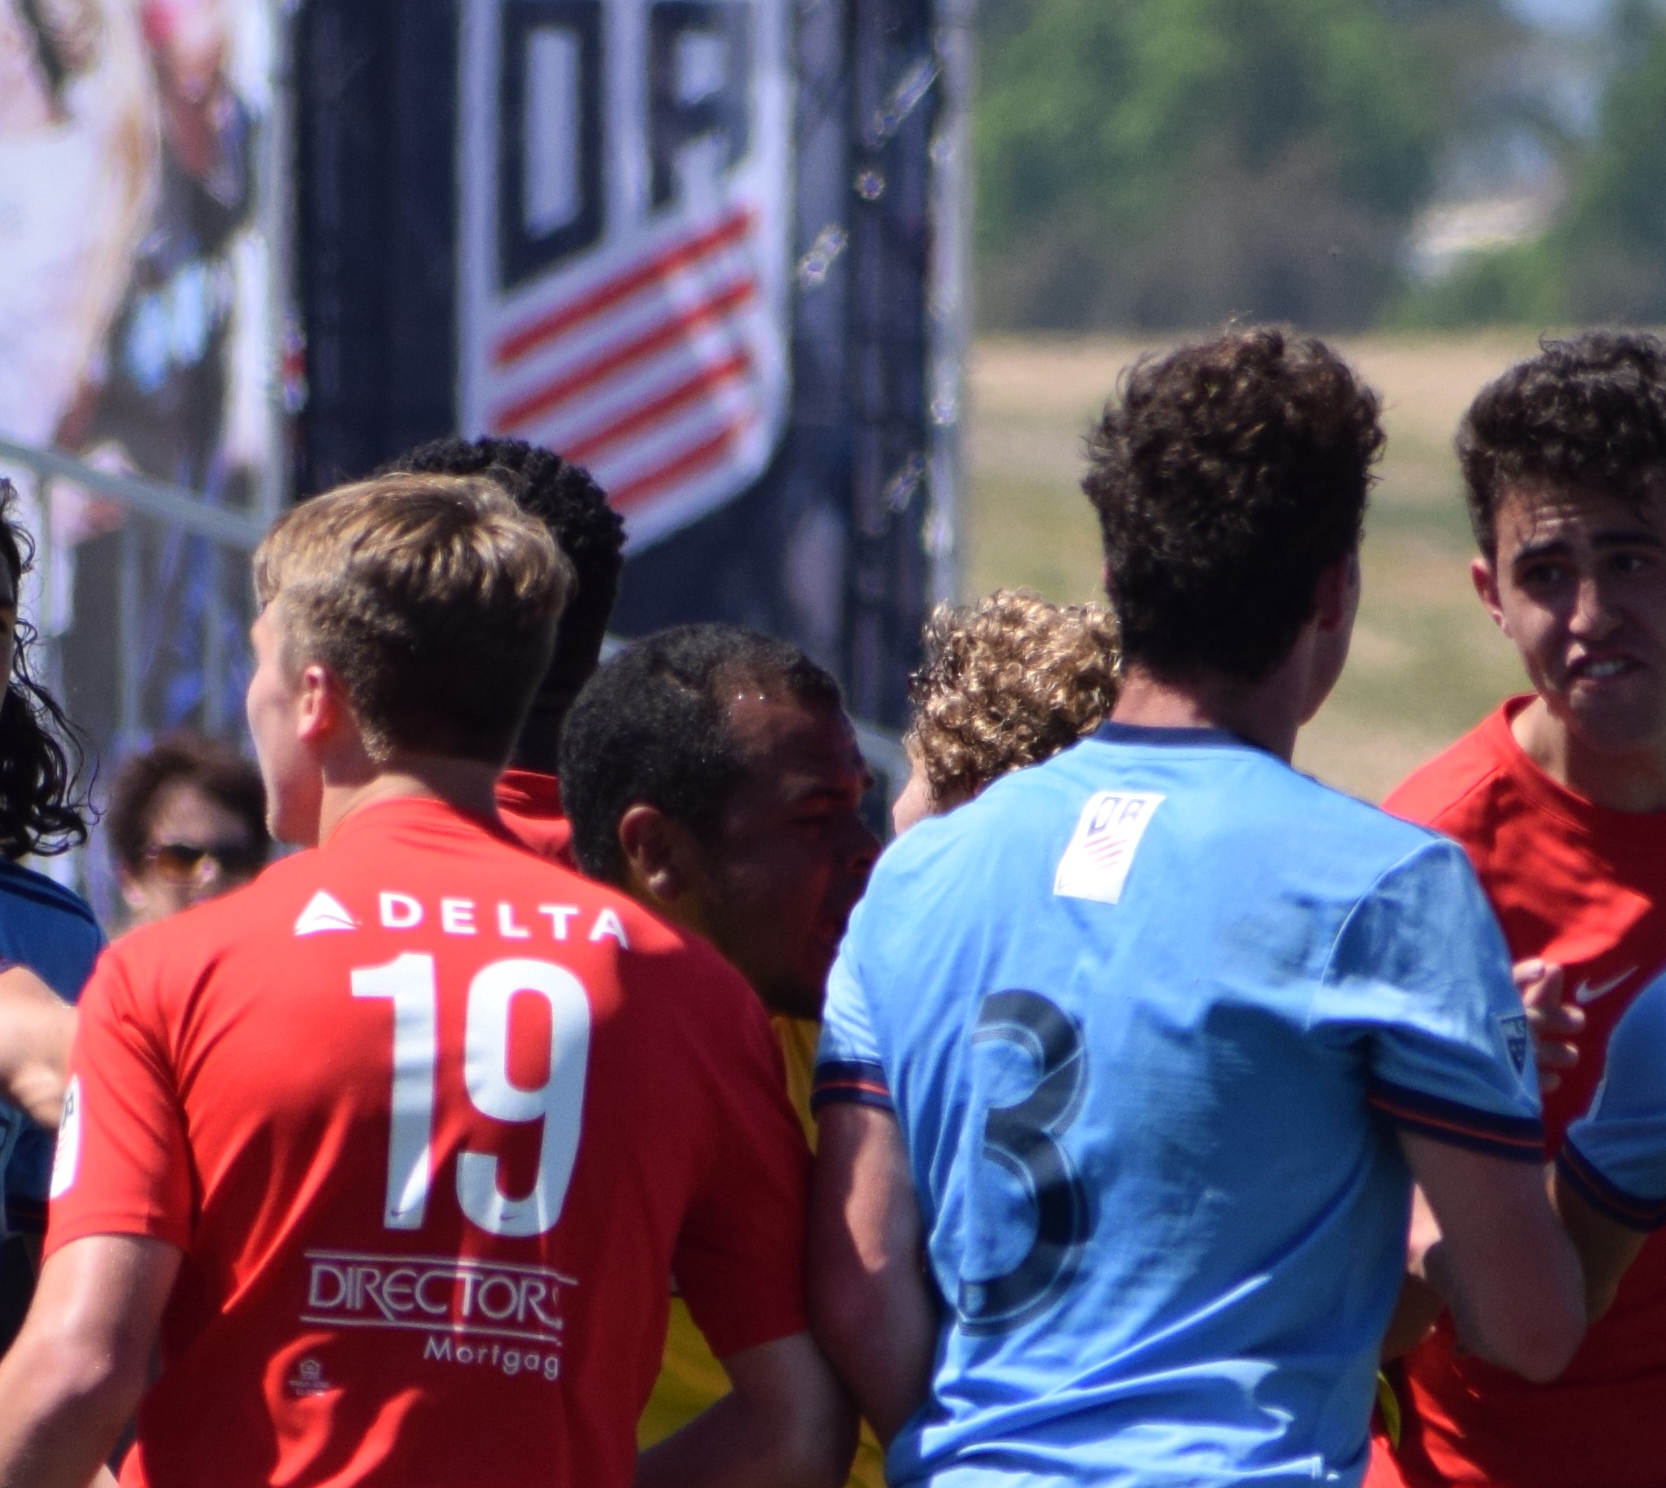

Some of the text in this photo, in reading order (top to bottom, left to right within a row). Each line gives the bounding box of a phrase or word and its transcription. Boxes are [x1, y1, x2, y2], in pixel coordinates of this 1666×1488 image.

[379, 891, 630, 951] DELTA
[349, 951, 593, 1239] 19
[955, 987, 1090, 1338] 3
[307, 1262, 565, 1331] DIRECTOR
[422, 1335, 560, 1381] Mortgag
